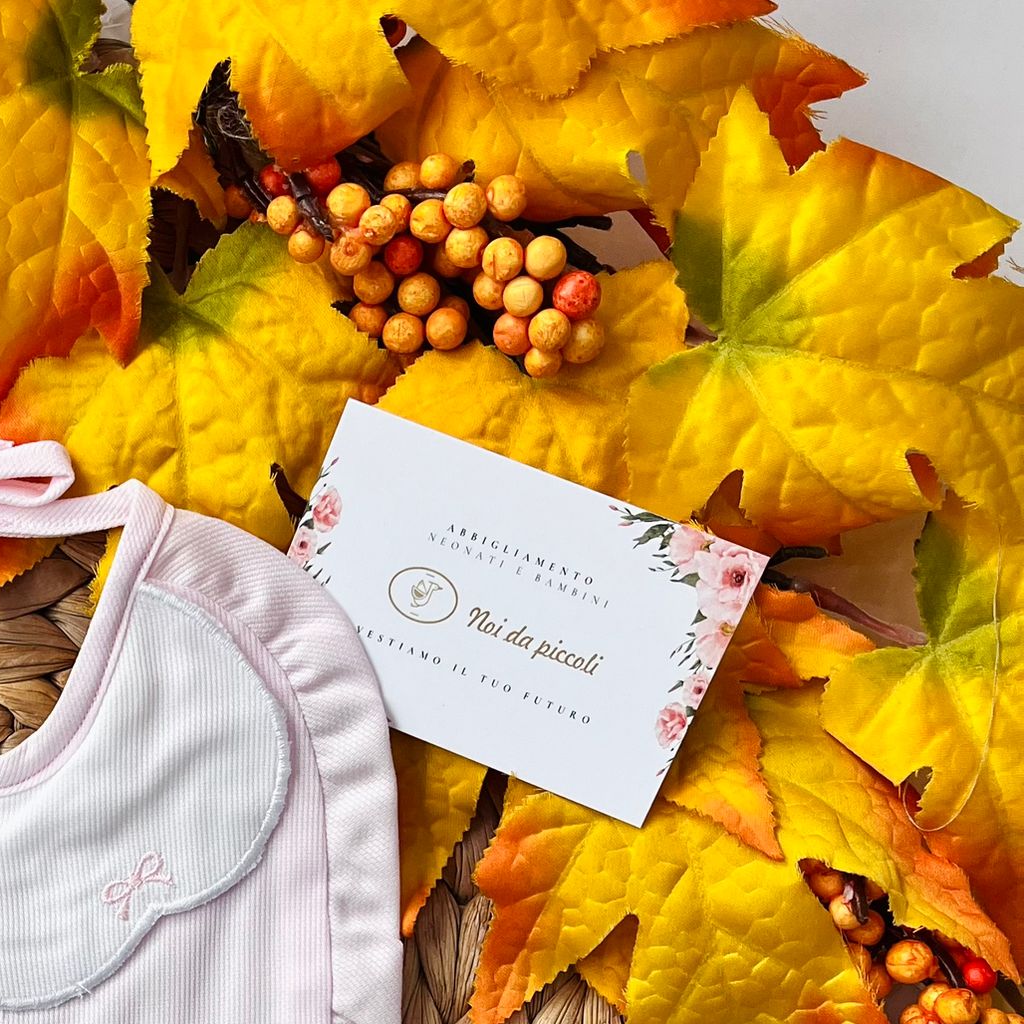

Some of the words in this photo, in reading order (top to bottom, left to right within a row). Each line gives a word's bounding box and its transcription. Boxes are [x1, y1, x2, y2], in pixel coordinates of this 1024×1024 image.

[428, 531, 506, 569] NEONATI
[516, 566, 524, 576] E
[534, 573, 610, 609] BAMBINI
[447, 523, 594, 586] ABBIGLIAMENTO
[356, 625, 441, 665] VESTIAMO
[452, 663, 468, 676] IL
[480, 674, 512, 693] TUO
[523, 691, 591, 724] FUTURO
[467, 606, 508, 638] Noi
[503, 625, 535, 650] da
[530, 639, 604, 676] piccoli
